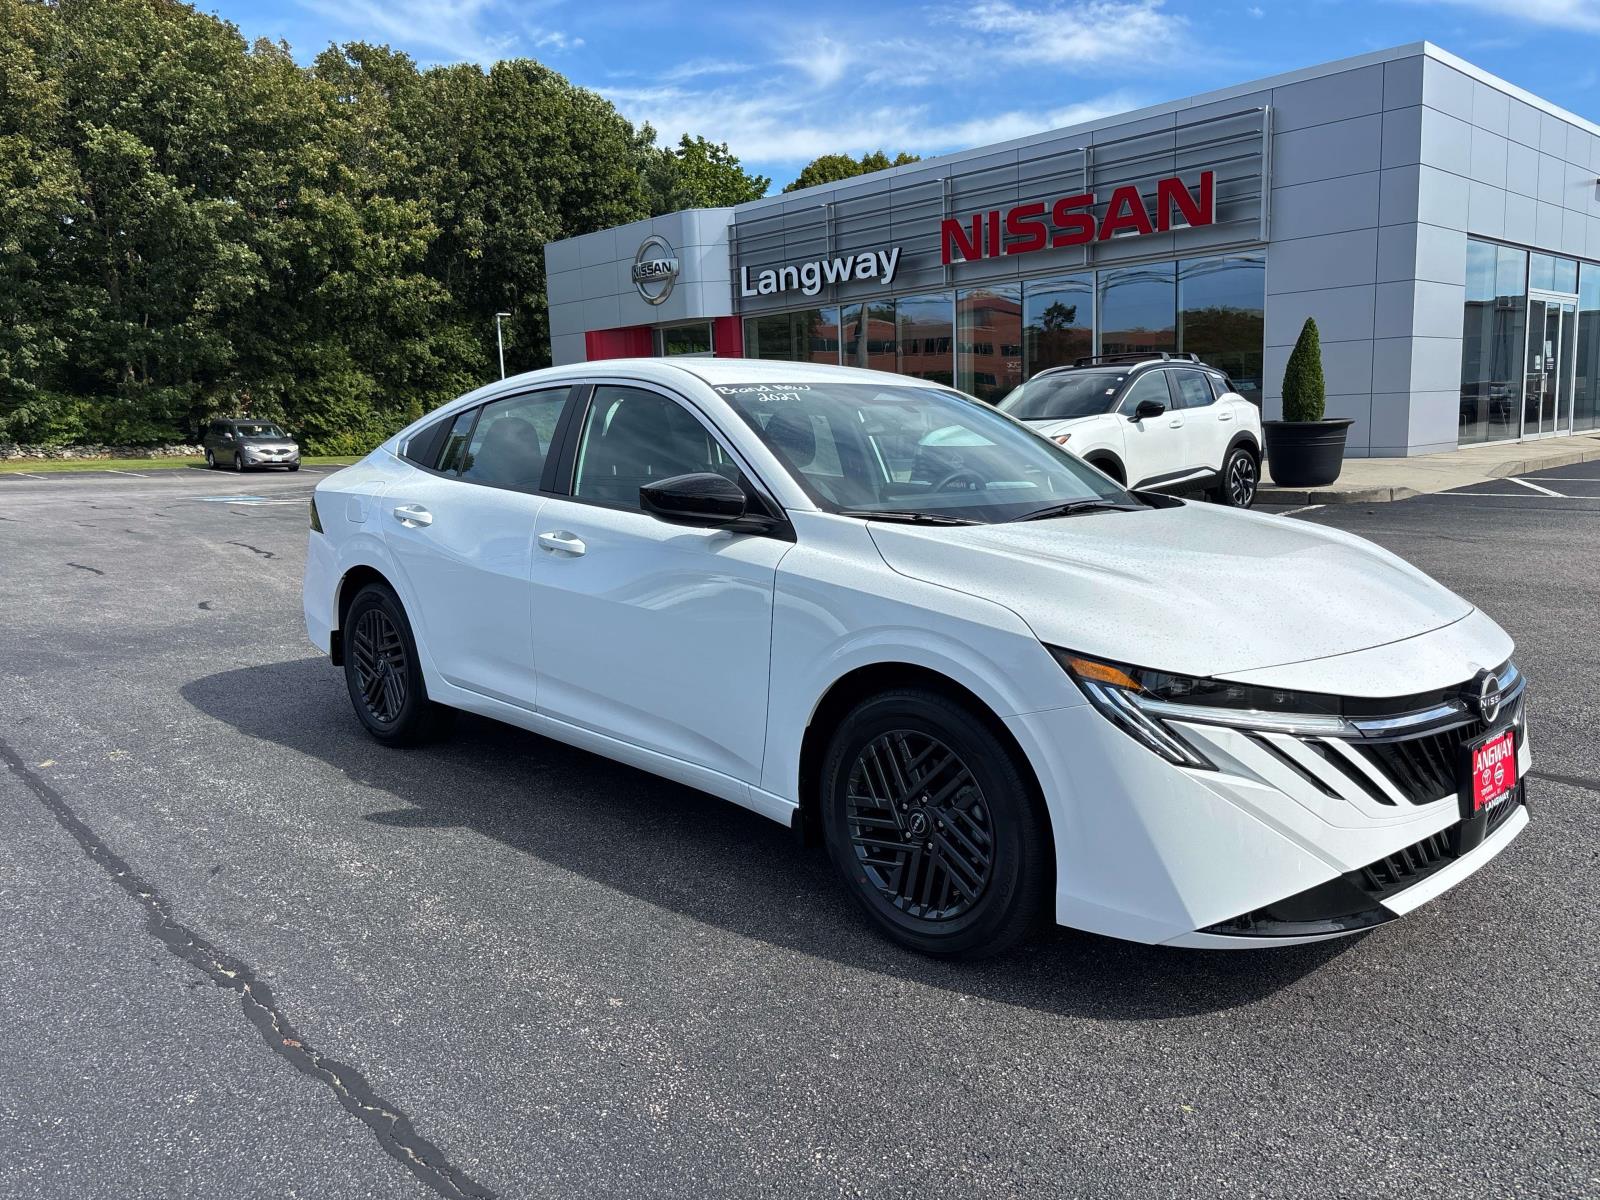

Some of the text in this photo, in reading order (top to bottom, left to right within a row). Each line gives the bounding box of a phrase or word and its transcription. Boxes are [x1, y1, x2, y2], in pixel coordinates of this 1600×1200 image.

[941, 170, 1217, 265] NISSAN
[632, 261, 672, 280] NISSAN
[740, 247, 902, 297] Langway
[714, 385, 773, 395] Brand
[1480, 694, 1501, 708] NISS
